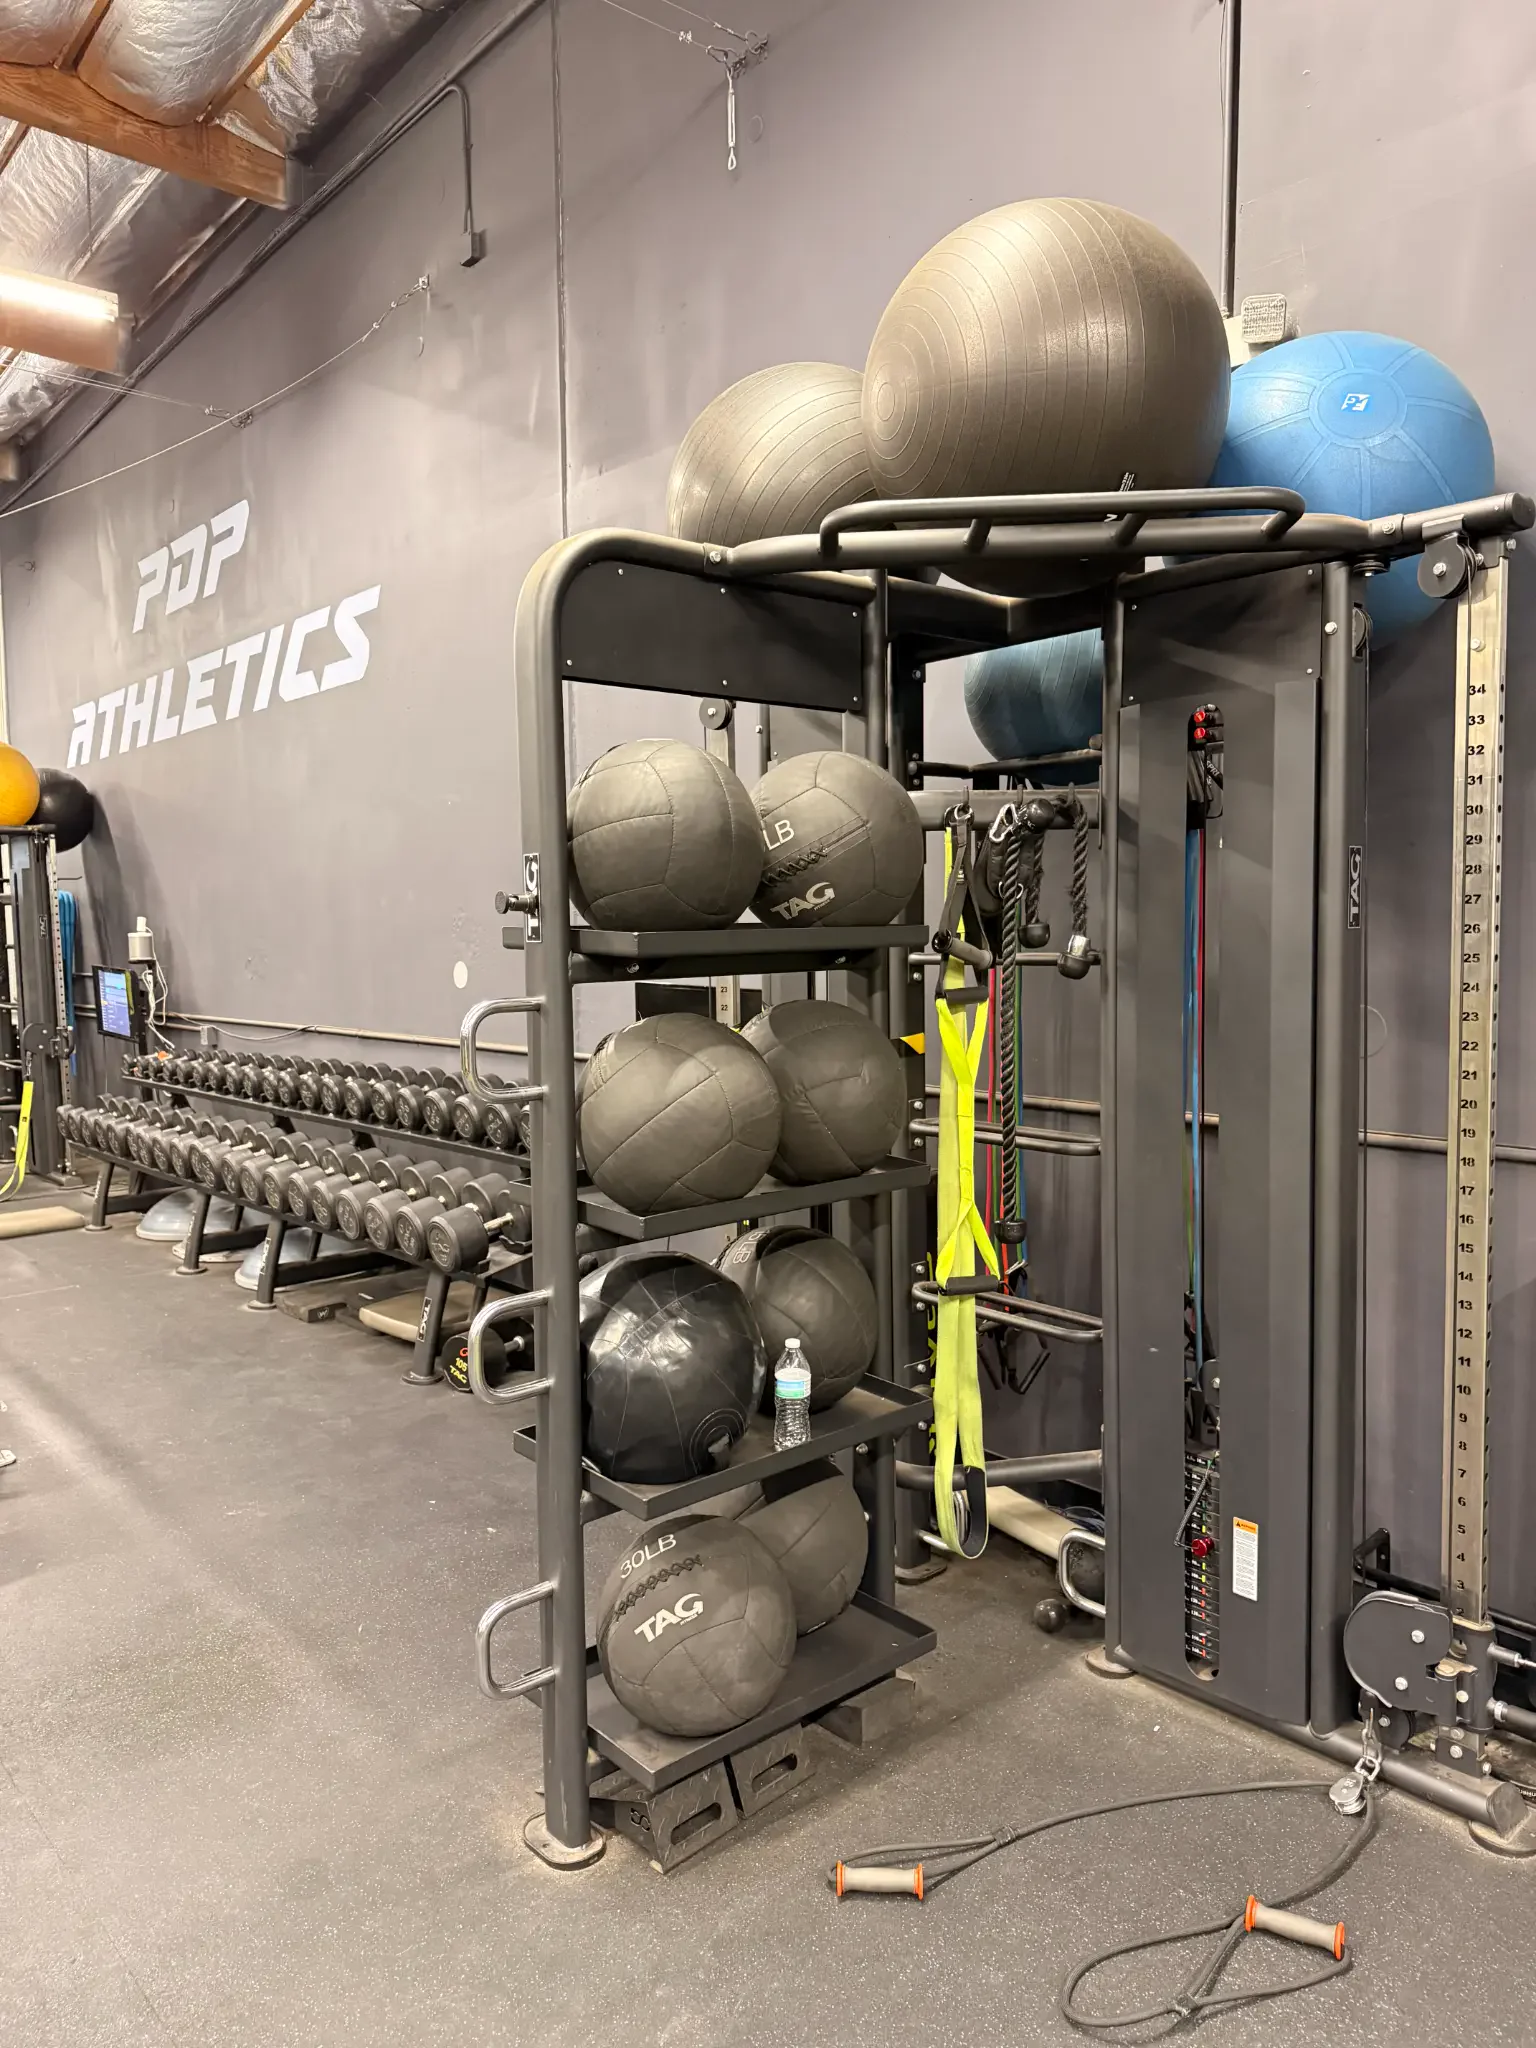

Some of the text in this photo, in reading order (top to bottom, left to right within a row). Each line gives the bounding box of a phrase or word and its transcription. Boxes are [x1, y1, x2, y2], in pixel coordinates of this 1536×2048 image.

[133, 499, 250, 633] PDP
[66, 584, 381, 769] ATHLETICS
[1469, 684, 1486, 694] 34
[1468, 715, 1485, 724] 33
[1467, 745, 1485, 755] 32
[1467, 775, 1483, 784] 31
[1466, 805, 1483, 814] 30
[1466, 835, 1483, 844] 29
[1465, 865, 1482, 873] 28
[1350, 853, 1361, 922] TAG
[770, 882, 836, 921] TAG
[1464, 894, 1481, 904] 27
[1464, 924, 1480, 933] 26
[1463, 954, 1480, 962] 25
[1463, 983, 1480, 992] 24
[1462, 1012, 1479, 1022] 23
[1462, 1041, 1479, 1051] 22
[1462, 1071, 1477, 1080] 21
[1461, 1100, 1478, 1109] 20
[1461, 1128, 1475, 1138] 19
[1461, 1157, 1474, 1166] 18
[1460, 1186, 1474, 1195] 17
[1460, 1215, 1473, 1224] 16
[1459, 1243, 1473, 1253] 15
[1459, 1272, 1473, 1281] 14
[1458, 1300, 1472, 1310] 13
[1458, 1329, 1472, 1338] 12
[1458, 1357, 1470, 1367] 11
[1457, 1385, 1471, 1395] 10
[1460, 1413, 1467, 1422] 9
[1459, 1441, 1466, 1450] 8
[1458, 1469, 1466, 1477] 7
[1458, 1497, 1466, 1506] 6
[1458, 1525, 1465, 1534] 5
[620, 1534, 677, 1579] 30LB
[1457, 1553, 1465, 1561] 4
[1457, 1580, 1464, 1590] 3
[633, 1593, 704, 1643] TAG
